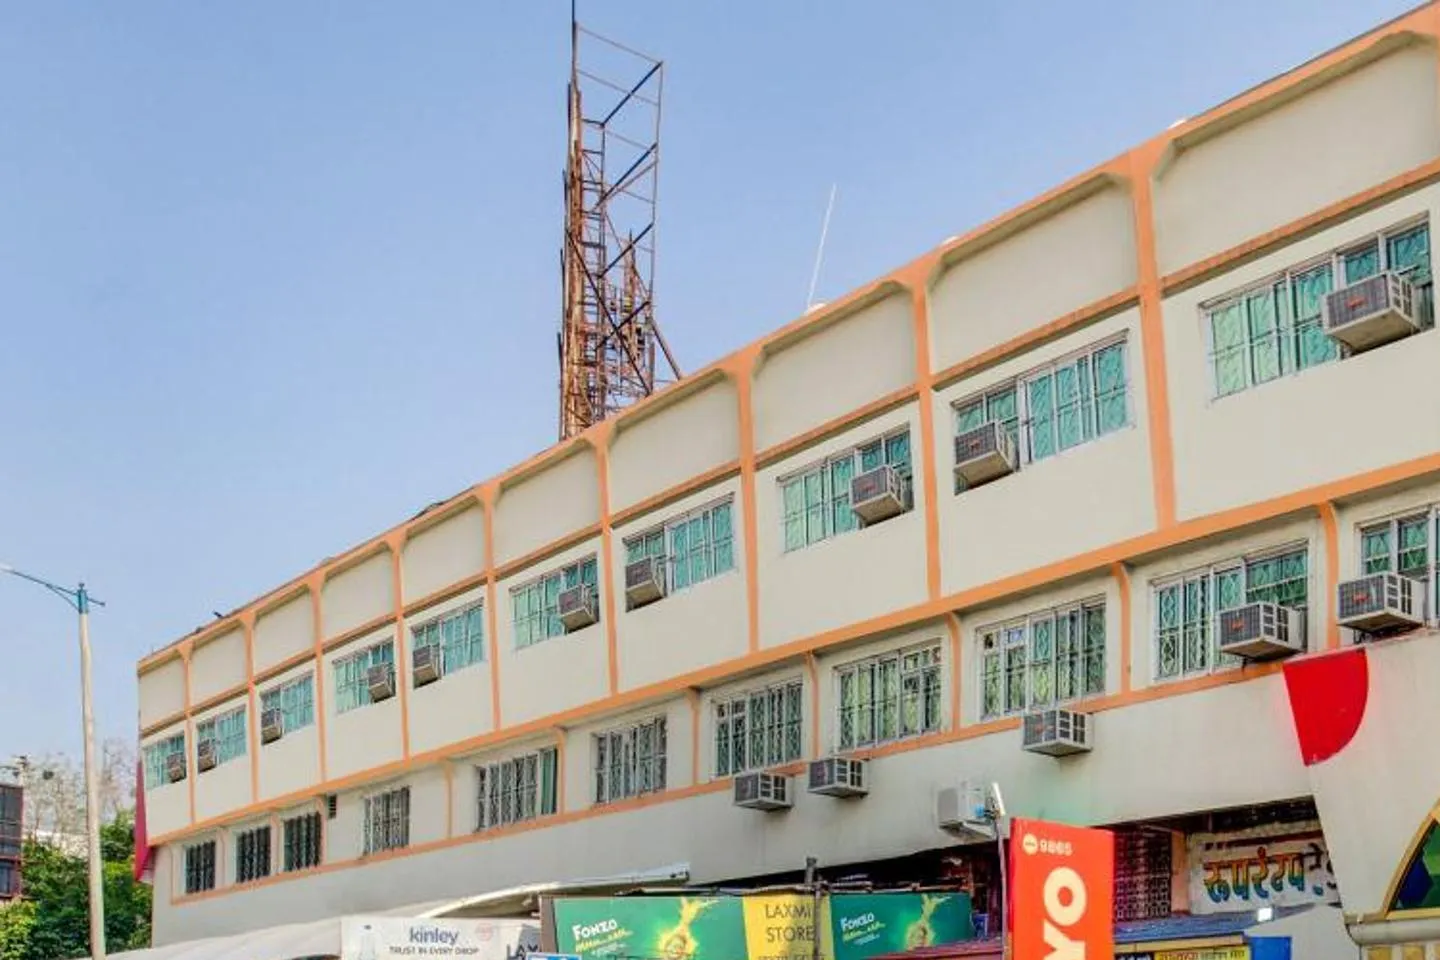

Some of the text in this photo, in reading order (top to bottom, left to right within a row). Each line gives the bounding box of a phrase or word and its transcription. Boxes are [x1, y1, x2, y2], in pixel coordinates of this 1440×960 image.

[764, 903, 812, 919] LAXMI
[408, 926, 460, 946] kinley
[766, 926, 816, 943] STORE
[389, 946, 415, 956] TRUST
[507, 944, 541, 960] LAX
